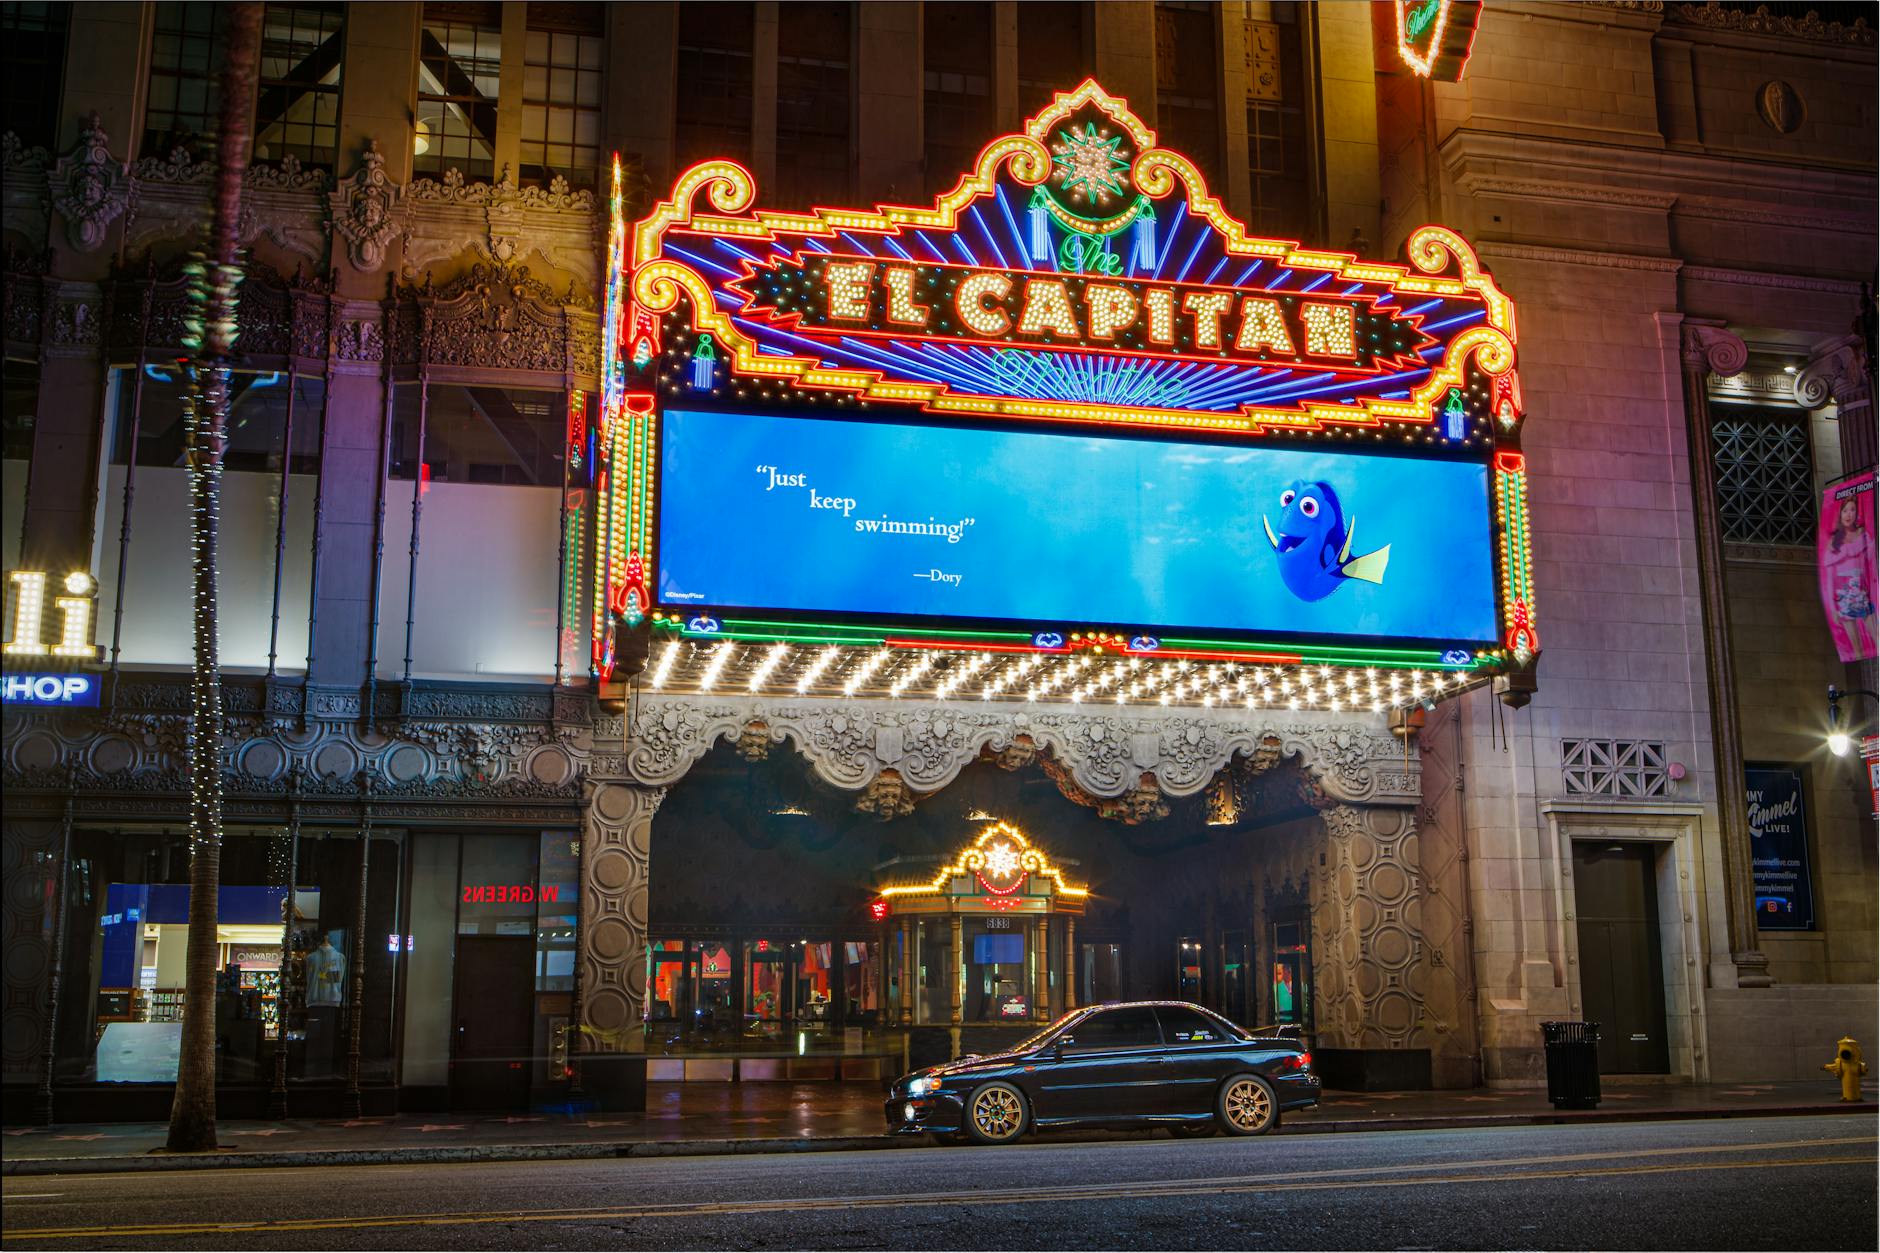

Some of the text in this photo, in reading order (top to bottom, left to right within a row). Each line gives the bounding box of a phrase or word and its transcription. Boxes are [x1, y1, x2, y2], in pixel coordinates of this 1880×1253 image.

[1060, 233, 1124, 276] The
[824, 262, 1357, 360] EL CAPITAN
[992, 348, 1190, 402] Theatre
[810, 489, 856, 517] keep
[1766, 825, 1790, 833] LIVE!
[987, 918, 1009, 928] 6838
